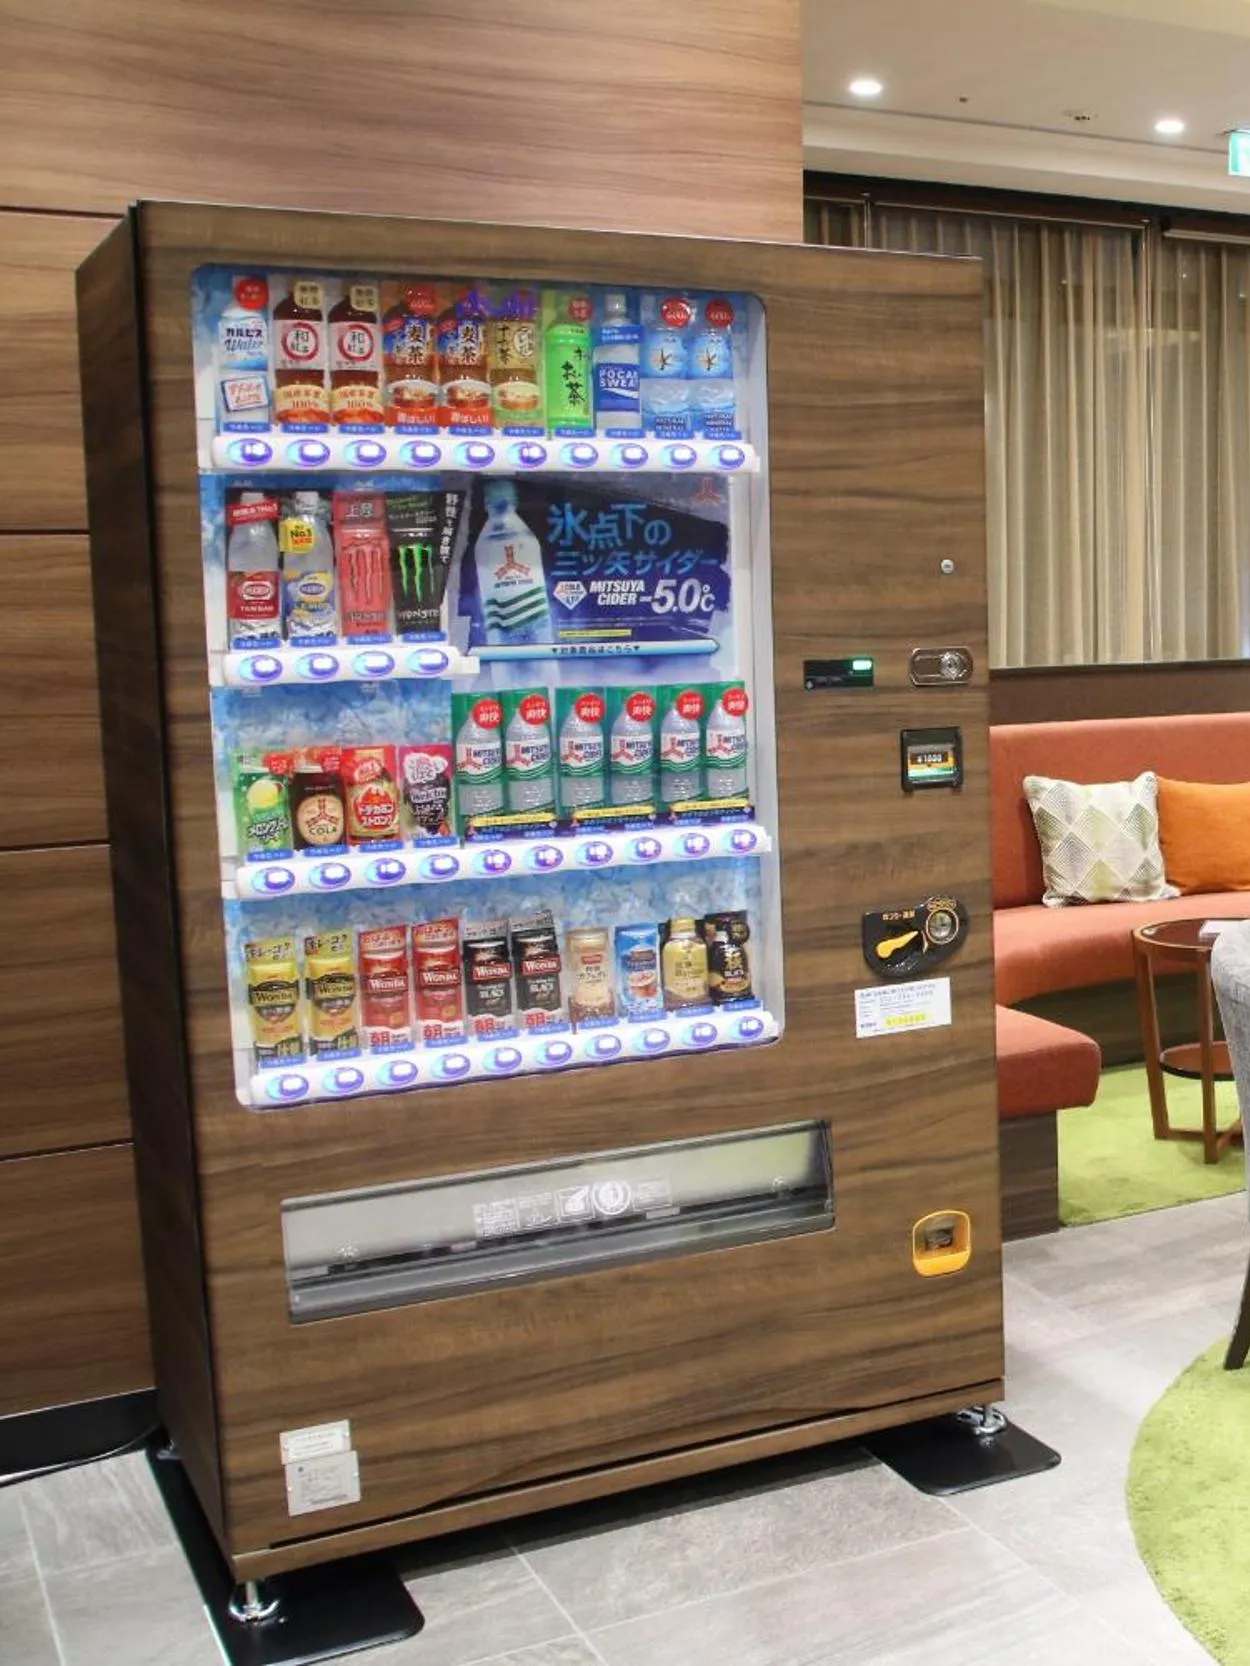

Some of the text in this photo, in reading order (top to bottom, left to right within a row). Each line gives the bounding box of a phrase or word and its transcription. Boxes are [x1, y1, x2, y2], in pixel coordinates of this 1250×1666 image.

[225, 328, 263, 337] カルピス
[546, 502, 672, 549] 氷点下の
[551, 549, 719, 576] 三ツ矢サイダー
[589, 581, 645, 594] MITSUYA
[597, 593, 638, 606] CIDER
[308, 825, 338, 836] COLA
